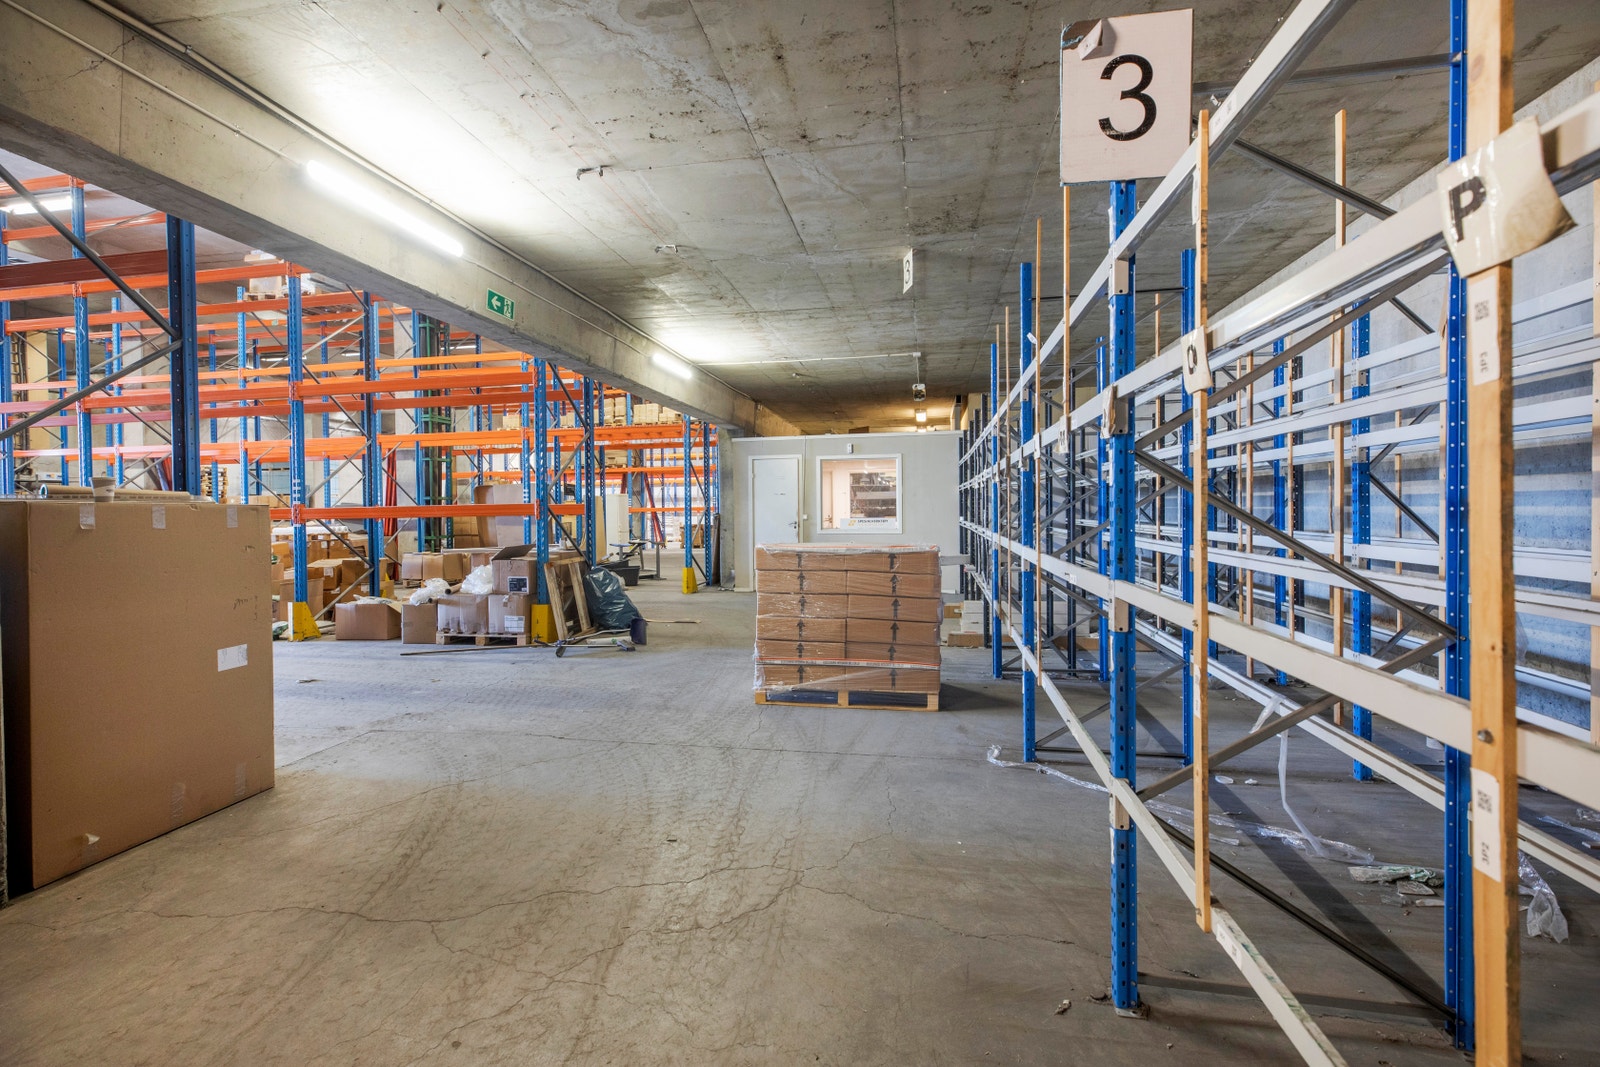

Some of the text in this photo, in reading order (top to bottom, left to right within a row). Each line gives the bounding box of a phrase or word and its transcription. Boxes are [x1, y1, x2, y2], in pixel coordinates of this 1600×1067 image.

[1098, 54, 1157, 141] 3
[1449, 176, 1487, 242] P
[905, 259, 910, 284] 3
